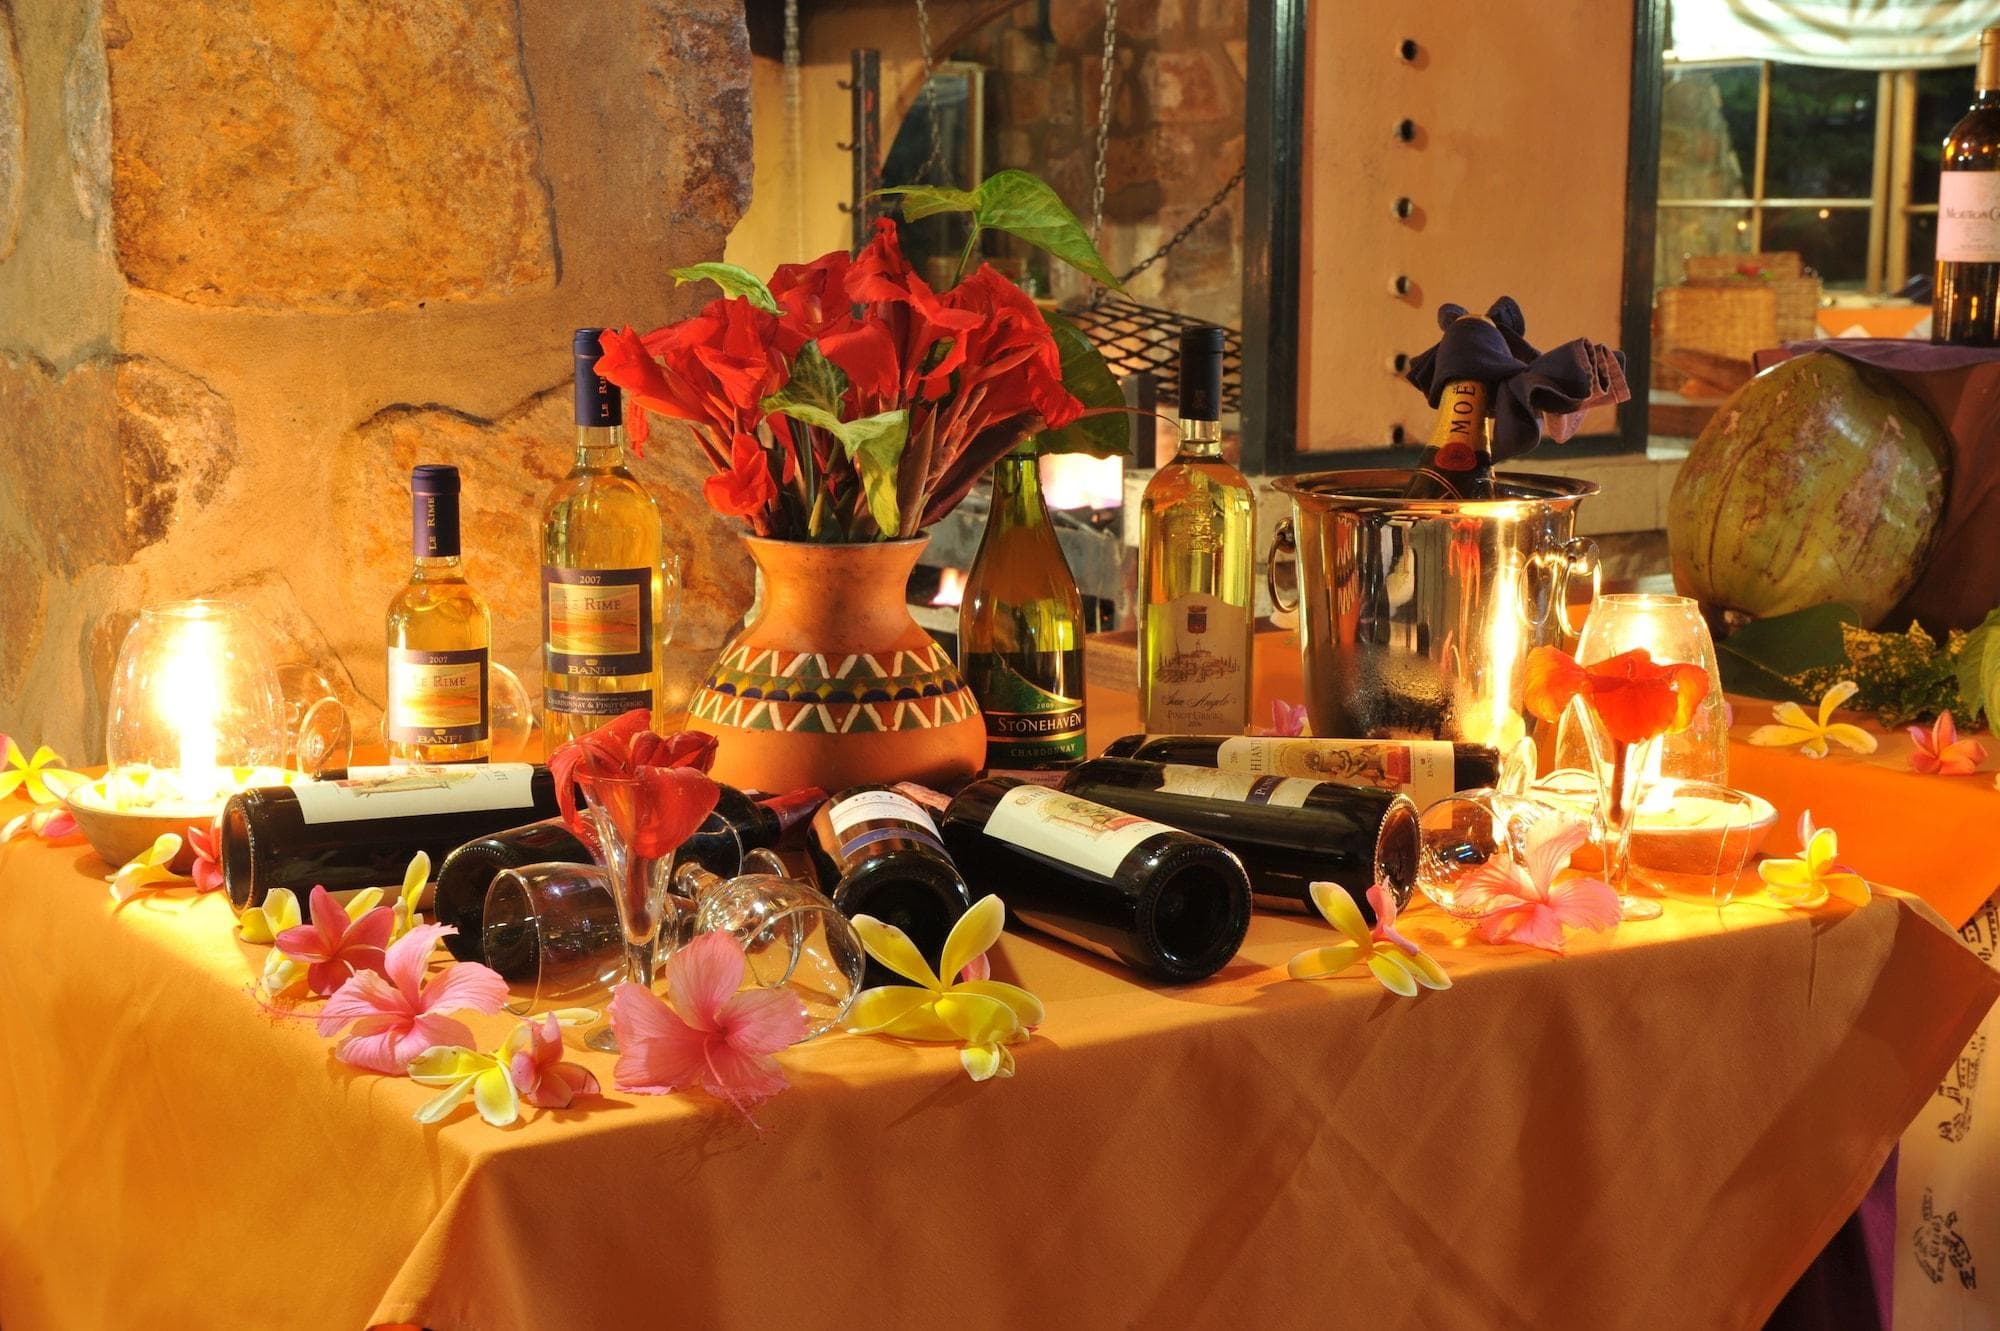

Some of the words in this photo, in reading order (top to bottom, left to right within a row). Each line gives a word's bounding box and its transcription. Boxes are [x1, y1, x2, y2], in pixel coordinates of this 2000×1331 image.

[1450, 383, 1475, 435] MOË
[427, 497, 435, 527] RIME
[579, 575, 602, 584] 2007
[429, 656, 448, 664] 2007
[998, 713, 1081, 733] STONEHAVEN
